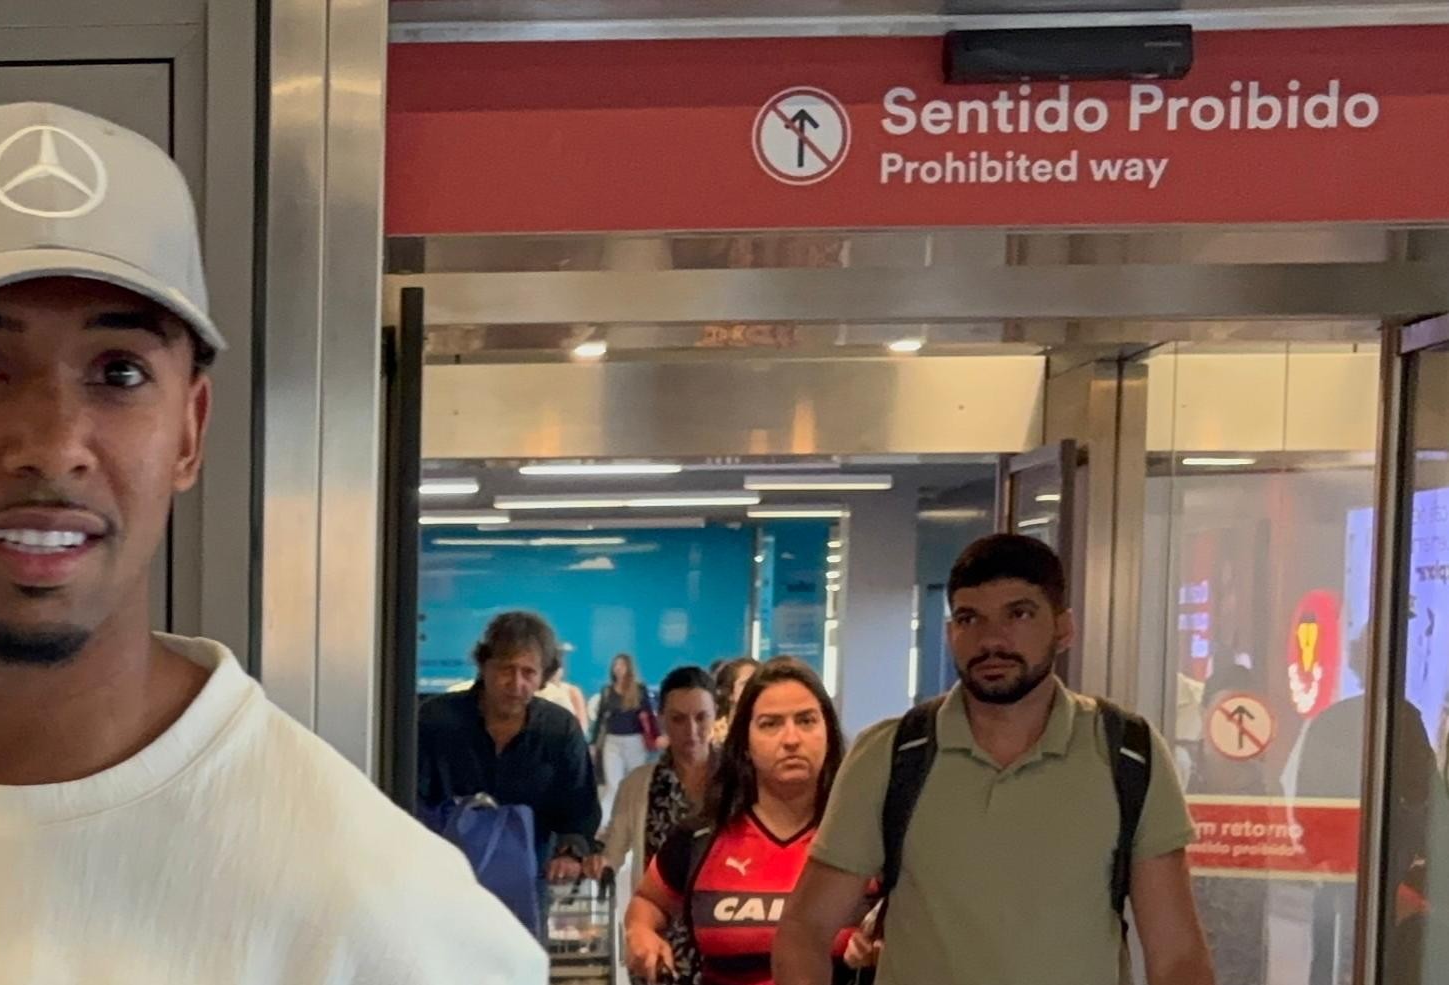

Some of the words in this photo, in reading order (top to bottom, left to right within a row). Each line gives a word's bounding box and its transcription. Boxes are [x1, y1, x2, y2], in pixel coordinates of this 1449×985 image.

[881, 85, 1108, 135] Sentido
[1128, 79, 1379, 131] Proibido
[880, 151, 1078, 183] Prohibited
[1089, 157, 1168, 188] way
[1221, 820, 1304, 838] retorno
[714, 897, 785, 921] CAI
